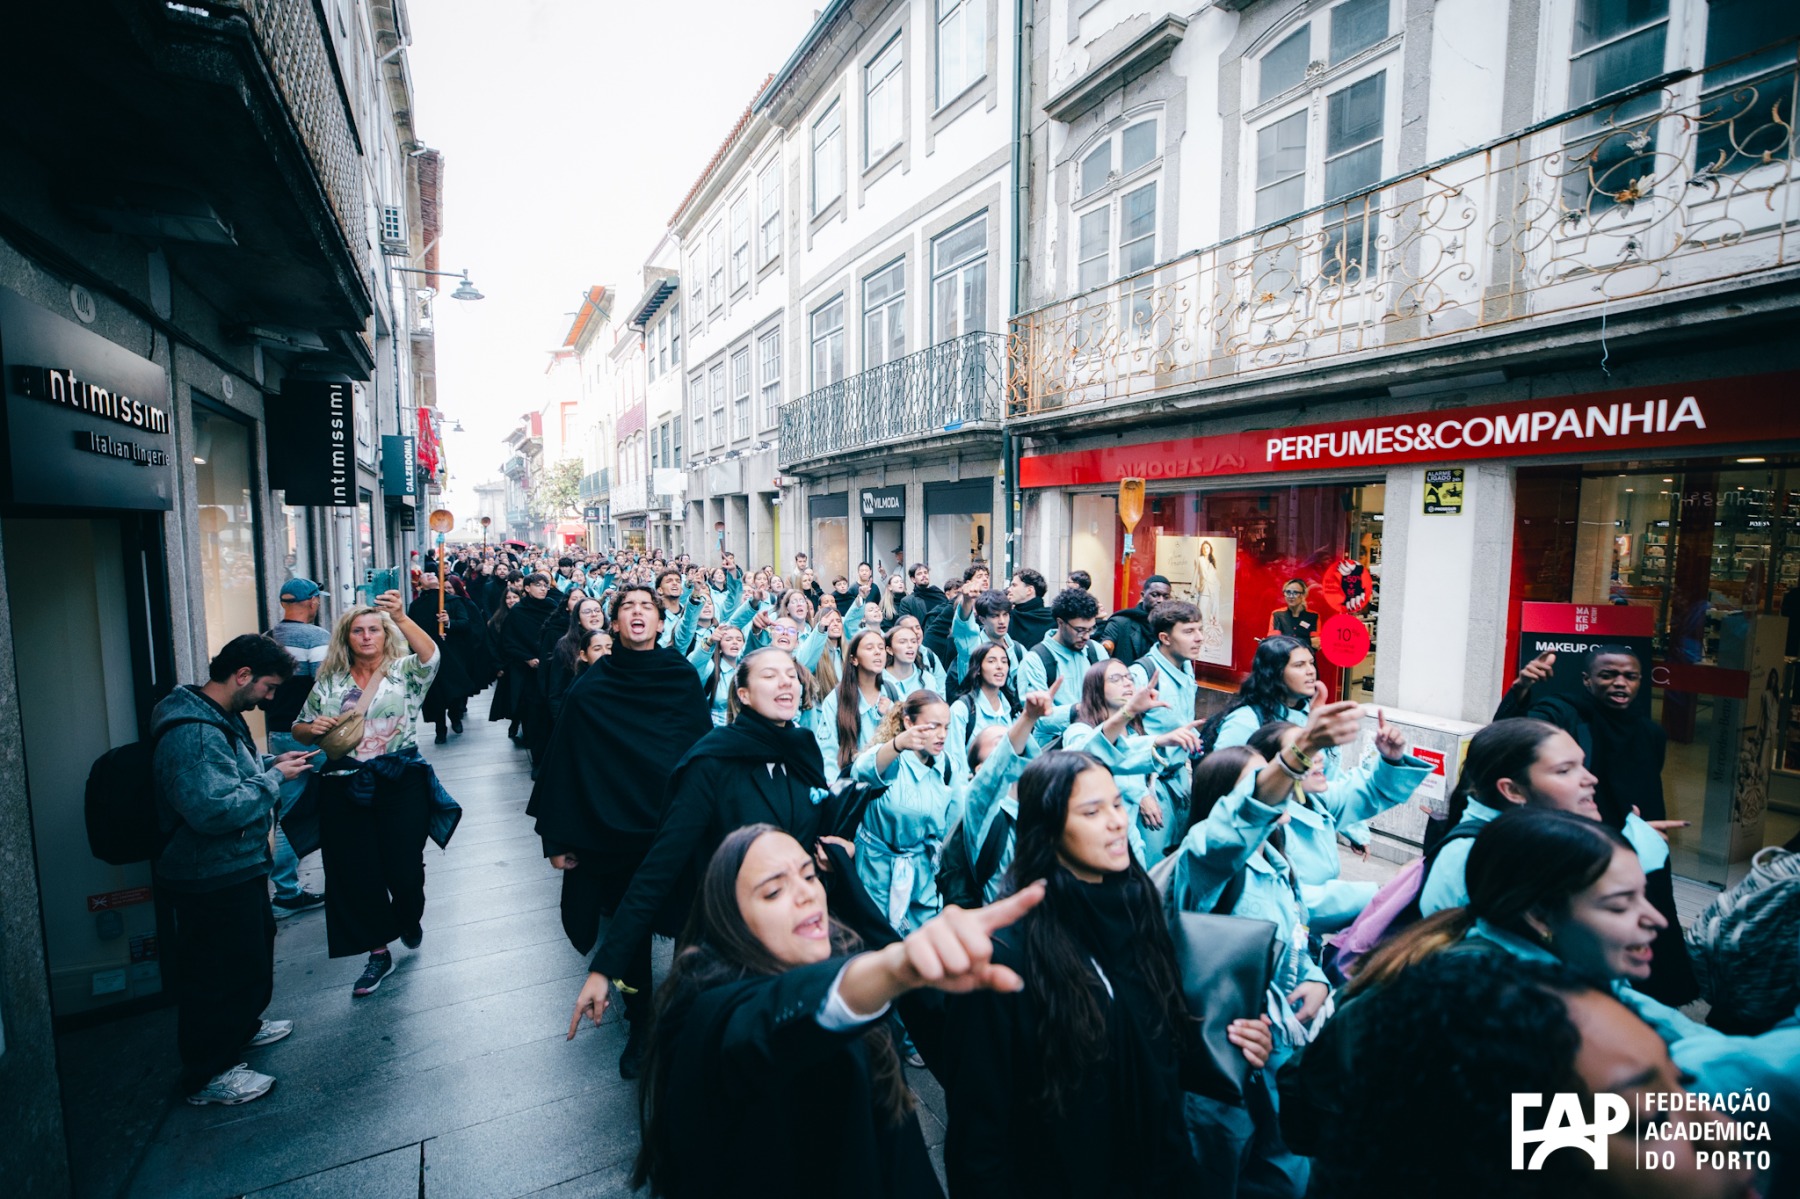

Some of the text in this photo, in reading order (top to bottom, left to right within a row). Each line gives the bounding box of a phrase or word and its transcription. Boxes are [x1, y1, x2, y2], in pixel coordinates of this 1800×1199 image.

[1266, 396, 1706, 462] PERFUMES&COMPANHIA
[90, 431, 171, 467] Italian lingerie
[403, 438, 415, 493] CALZEDONIA
[874, 496, 900, 508] VILMODA
[1536, 641, 1588, 653] MAKEUP
